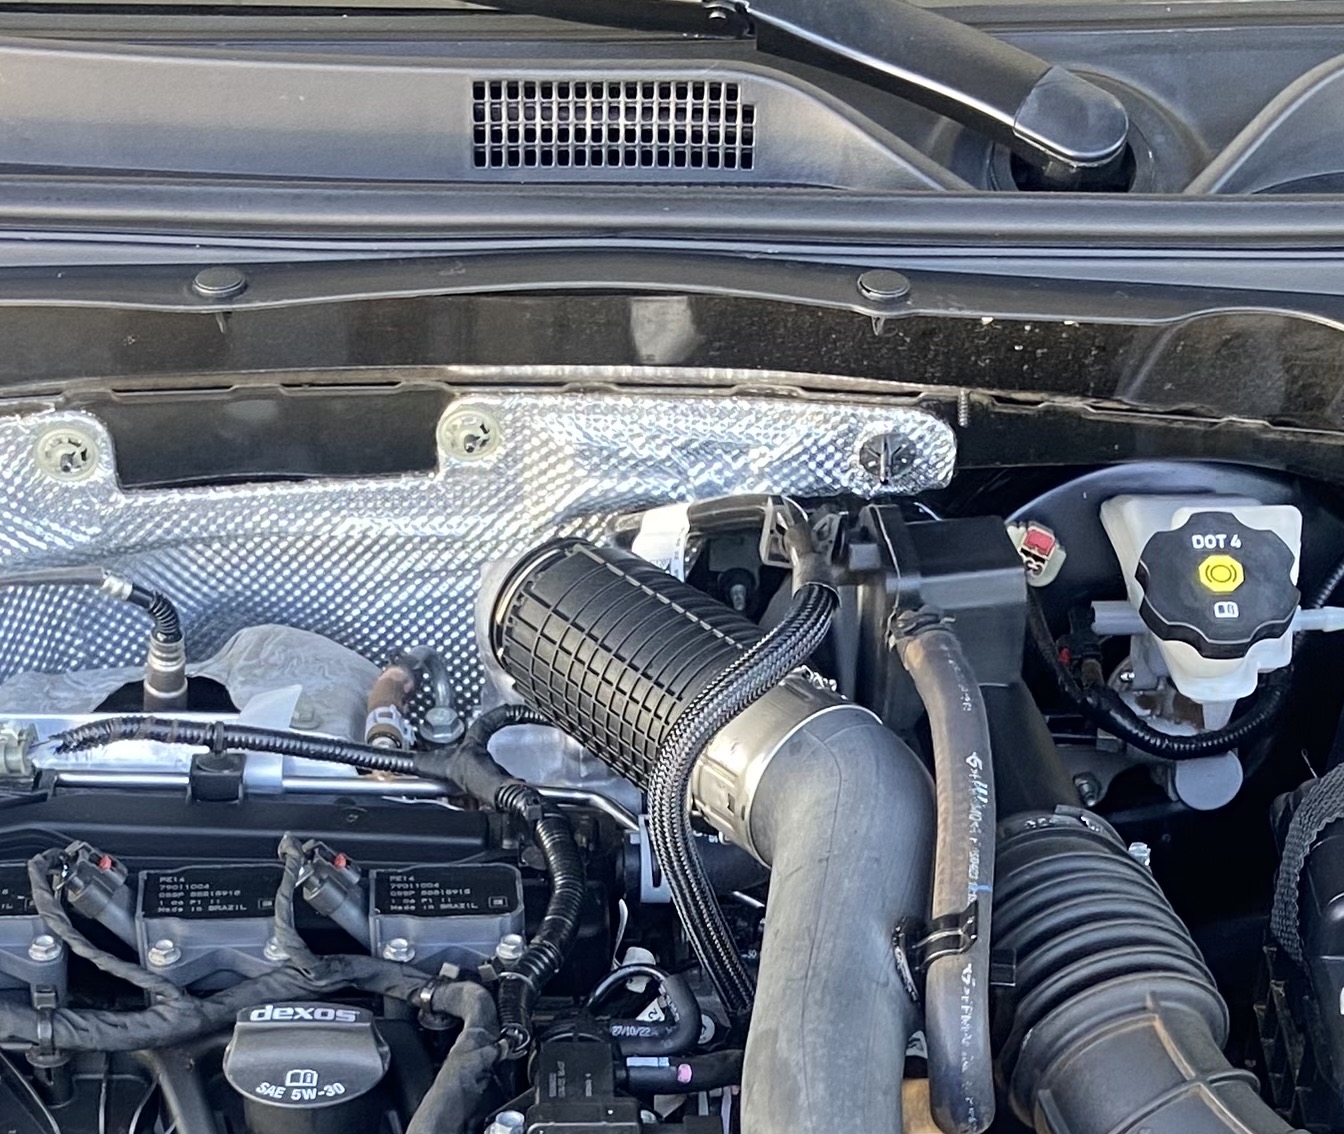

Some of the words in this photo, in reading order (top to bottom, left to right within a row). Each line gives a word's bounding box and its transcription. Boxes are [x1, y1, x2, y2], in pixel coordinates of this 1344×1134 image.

[1191, 534, 1227, 549] DOT
[1230, 534, 1242, 549] 4
[250, 1005, 357, 1022] dexos
[256, 1081, 286, 1099] SAE
[291, 1082, 346, 1100] 5W-30
